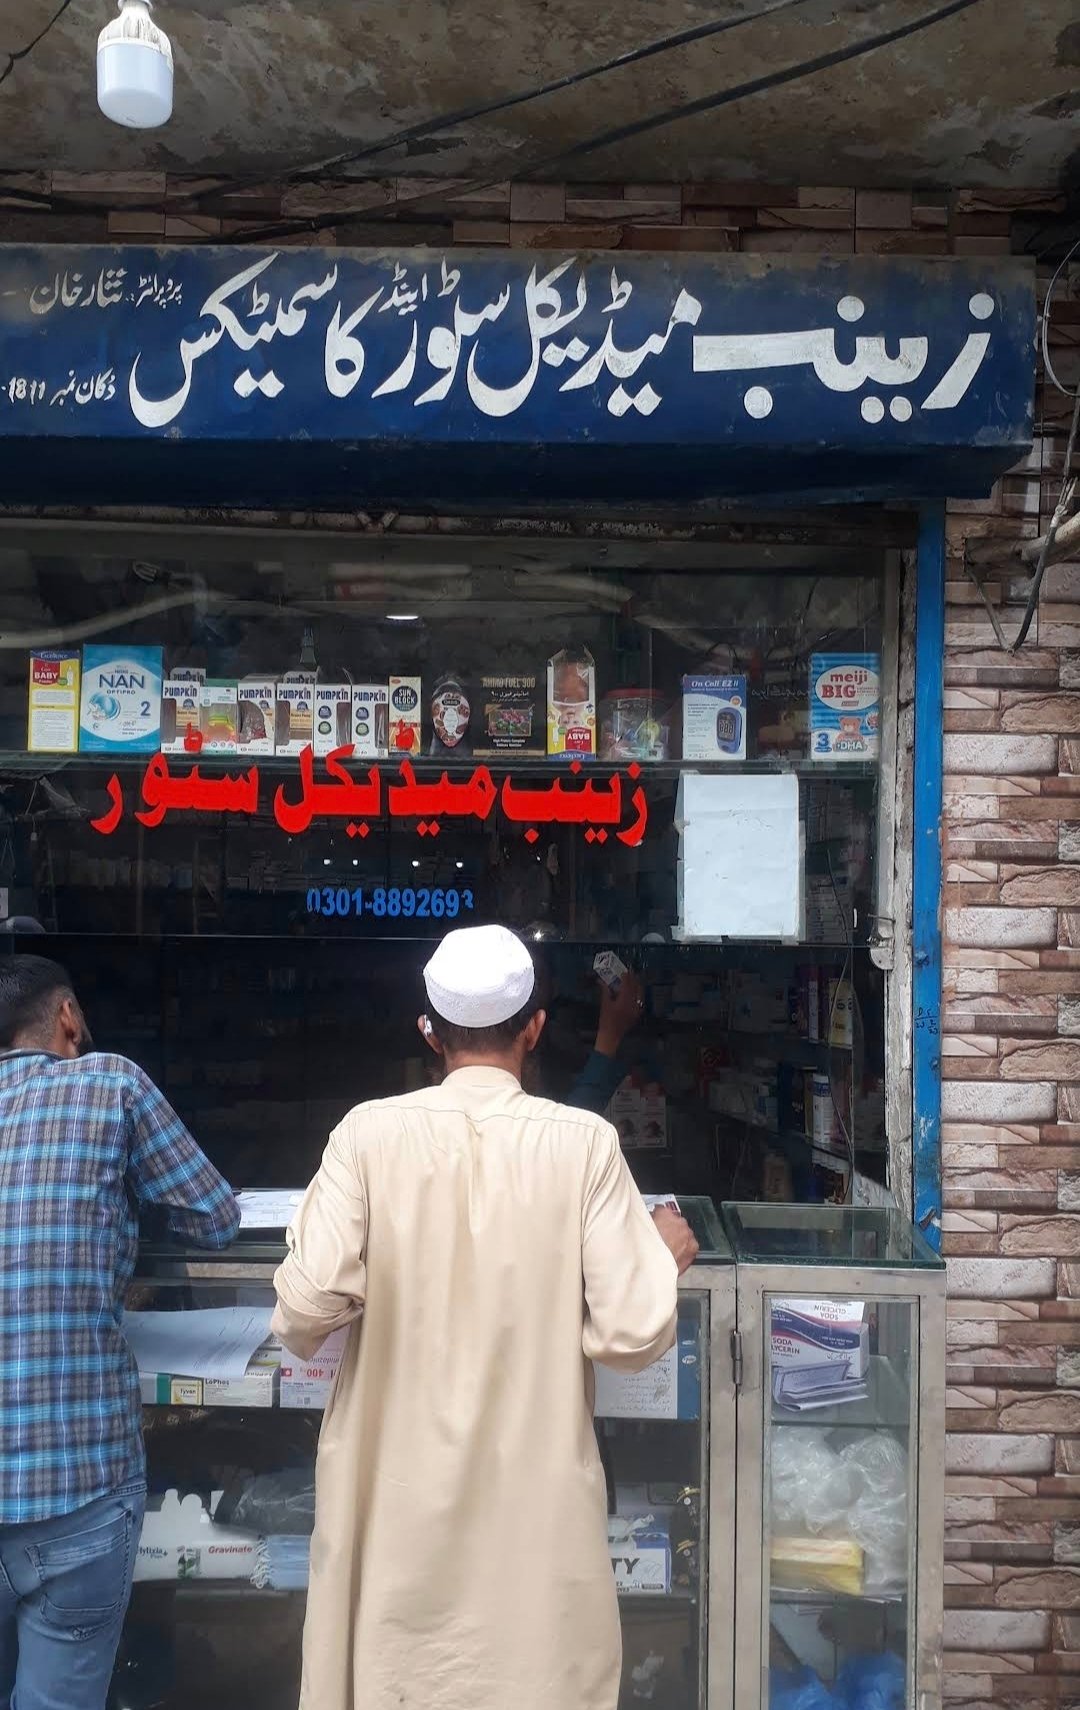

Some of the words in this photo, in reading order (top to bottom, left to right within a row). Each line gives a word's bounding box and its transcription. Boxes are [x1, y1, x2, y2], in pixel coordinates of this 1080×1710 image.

[29, 269, 83, 315] خان
[469, 256, 702, 417] میڈیکل
[692, 292, 994, 423] زینب
[49, 369, 76, 406] نمبر
[34, 672, 58, 680] BABY
[99, 674, 145, 689] NAN
[830, 670, 868, 685] meiji
[398, 688, 412, 696] SUN
[821, 684, 856, 698] BIG
[394, 696, 415, 704] BLOCK
[140, 701, 151, 717] 2
[817, 732, 829, 747] 3
[274, 717, 498, 838] میڈیکل
[501, 760, 648, 847] زینب
[814, 1304, 847, 1315] GLYCERIN
[820, 1311, 839, 1321] SODA
[772, 1337, 793, 1346] SODA
[771, 1344, 800, 1355] LYCERIN
[307, 1369, 325, 1378] 400
[207, 1545, 253, 1555] Gravinate
